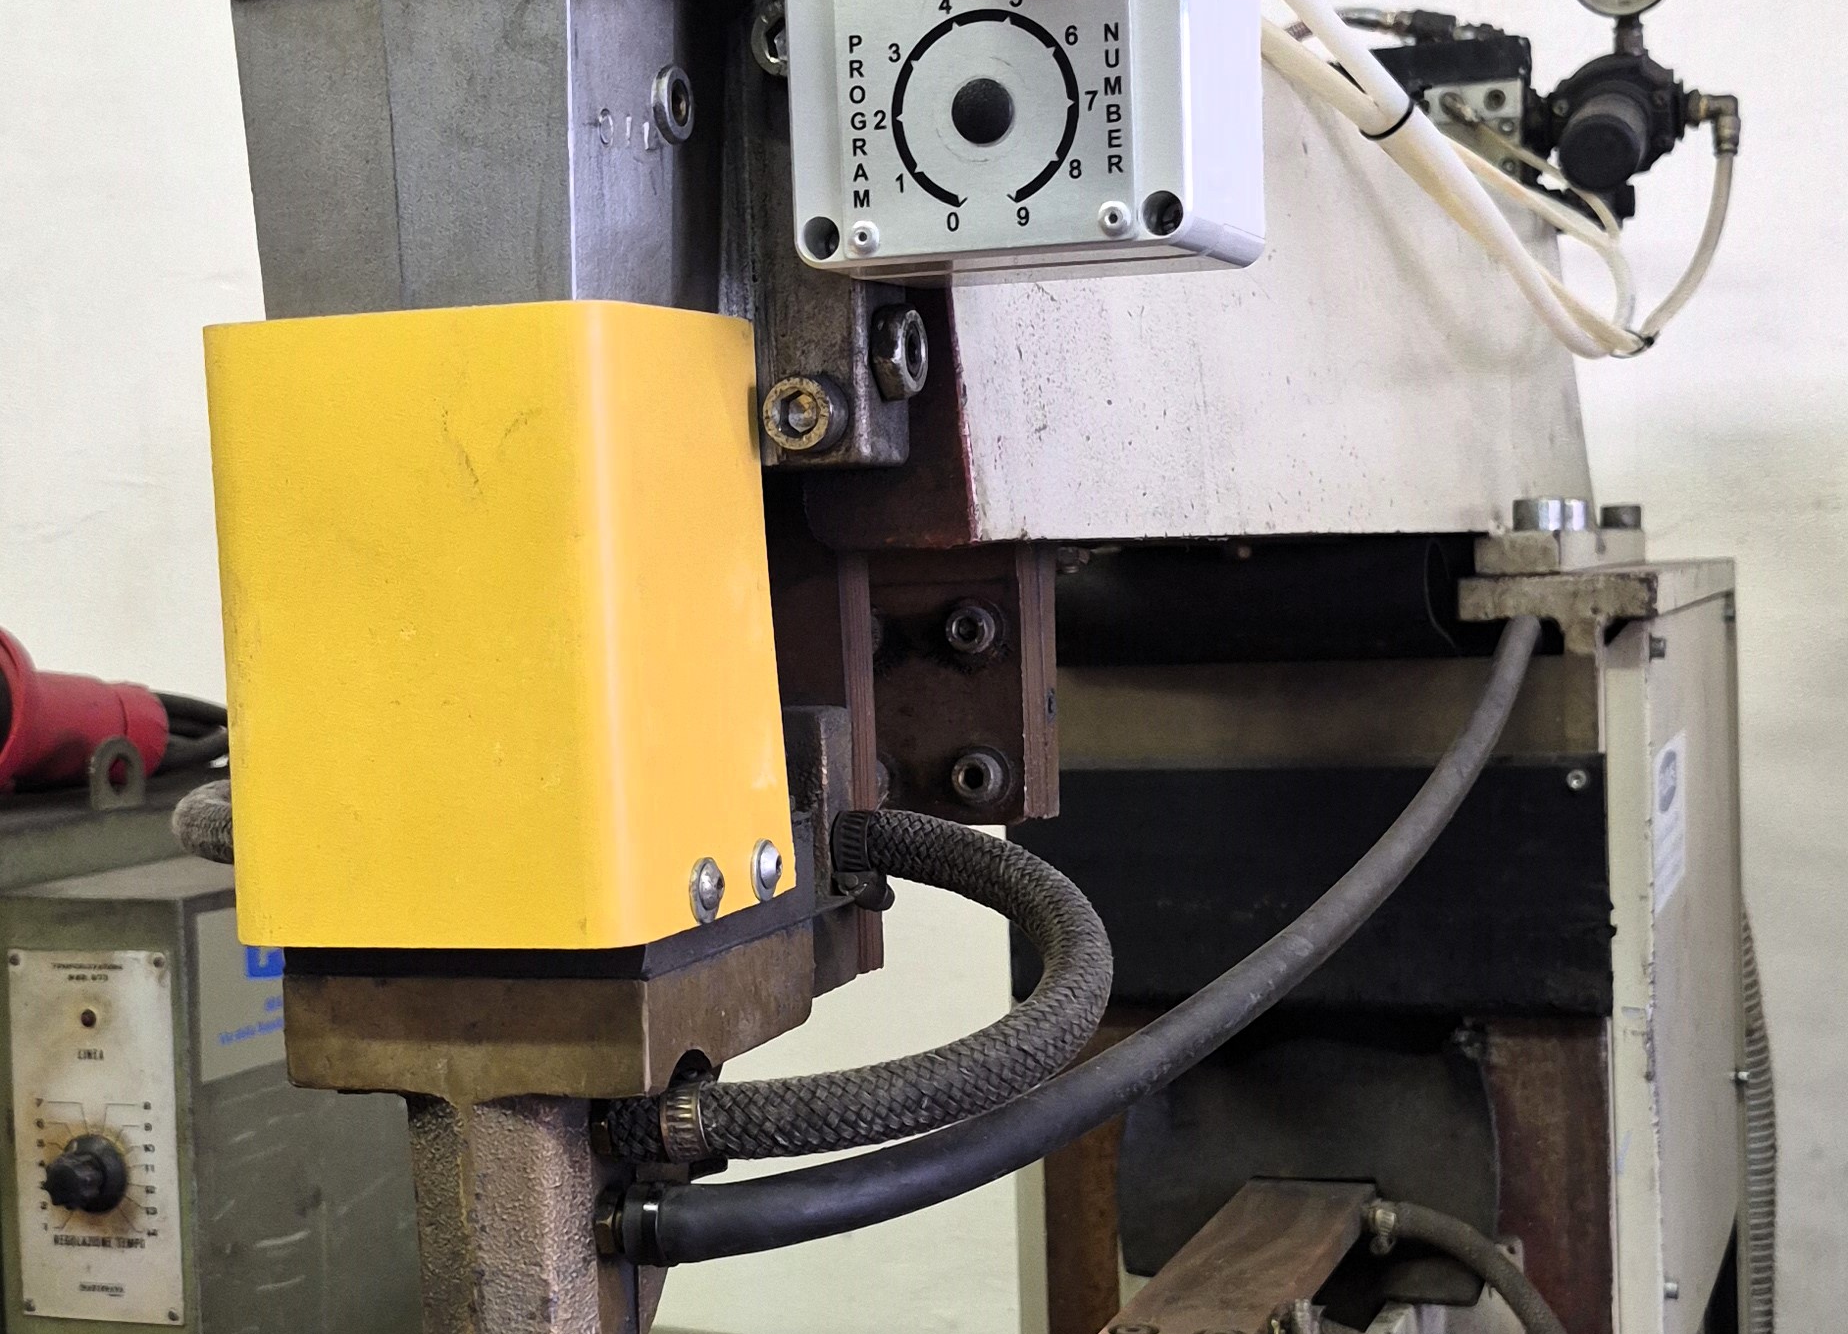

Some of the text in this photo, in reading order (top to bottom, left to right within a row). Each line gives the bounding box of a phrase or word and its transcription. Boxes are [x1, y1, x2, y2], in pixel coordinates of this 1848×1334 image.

[1065, 25, 1079, 45] 6
[888, 43, 901, 63] 3
[1084, 90, 1098, 111] 7
[1103, 22, 1124, 174] NUMBER
[848, 35, 870, 208] PROGRAM
[873, 110, 887, 130] 2
[1068, 158, 1082, 179] 8
[896, 174, 904, 193] 1
[946, 212, 960, 232] 0
[1016, 207, 1030, 226] 9
